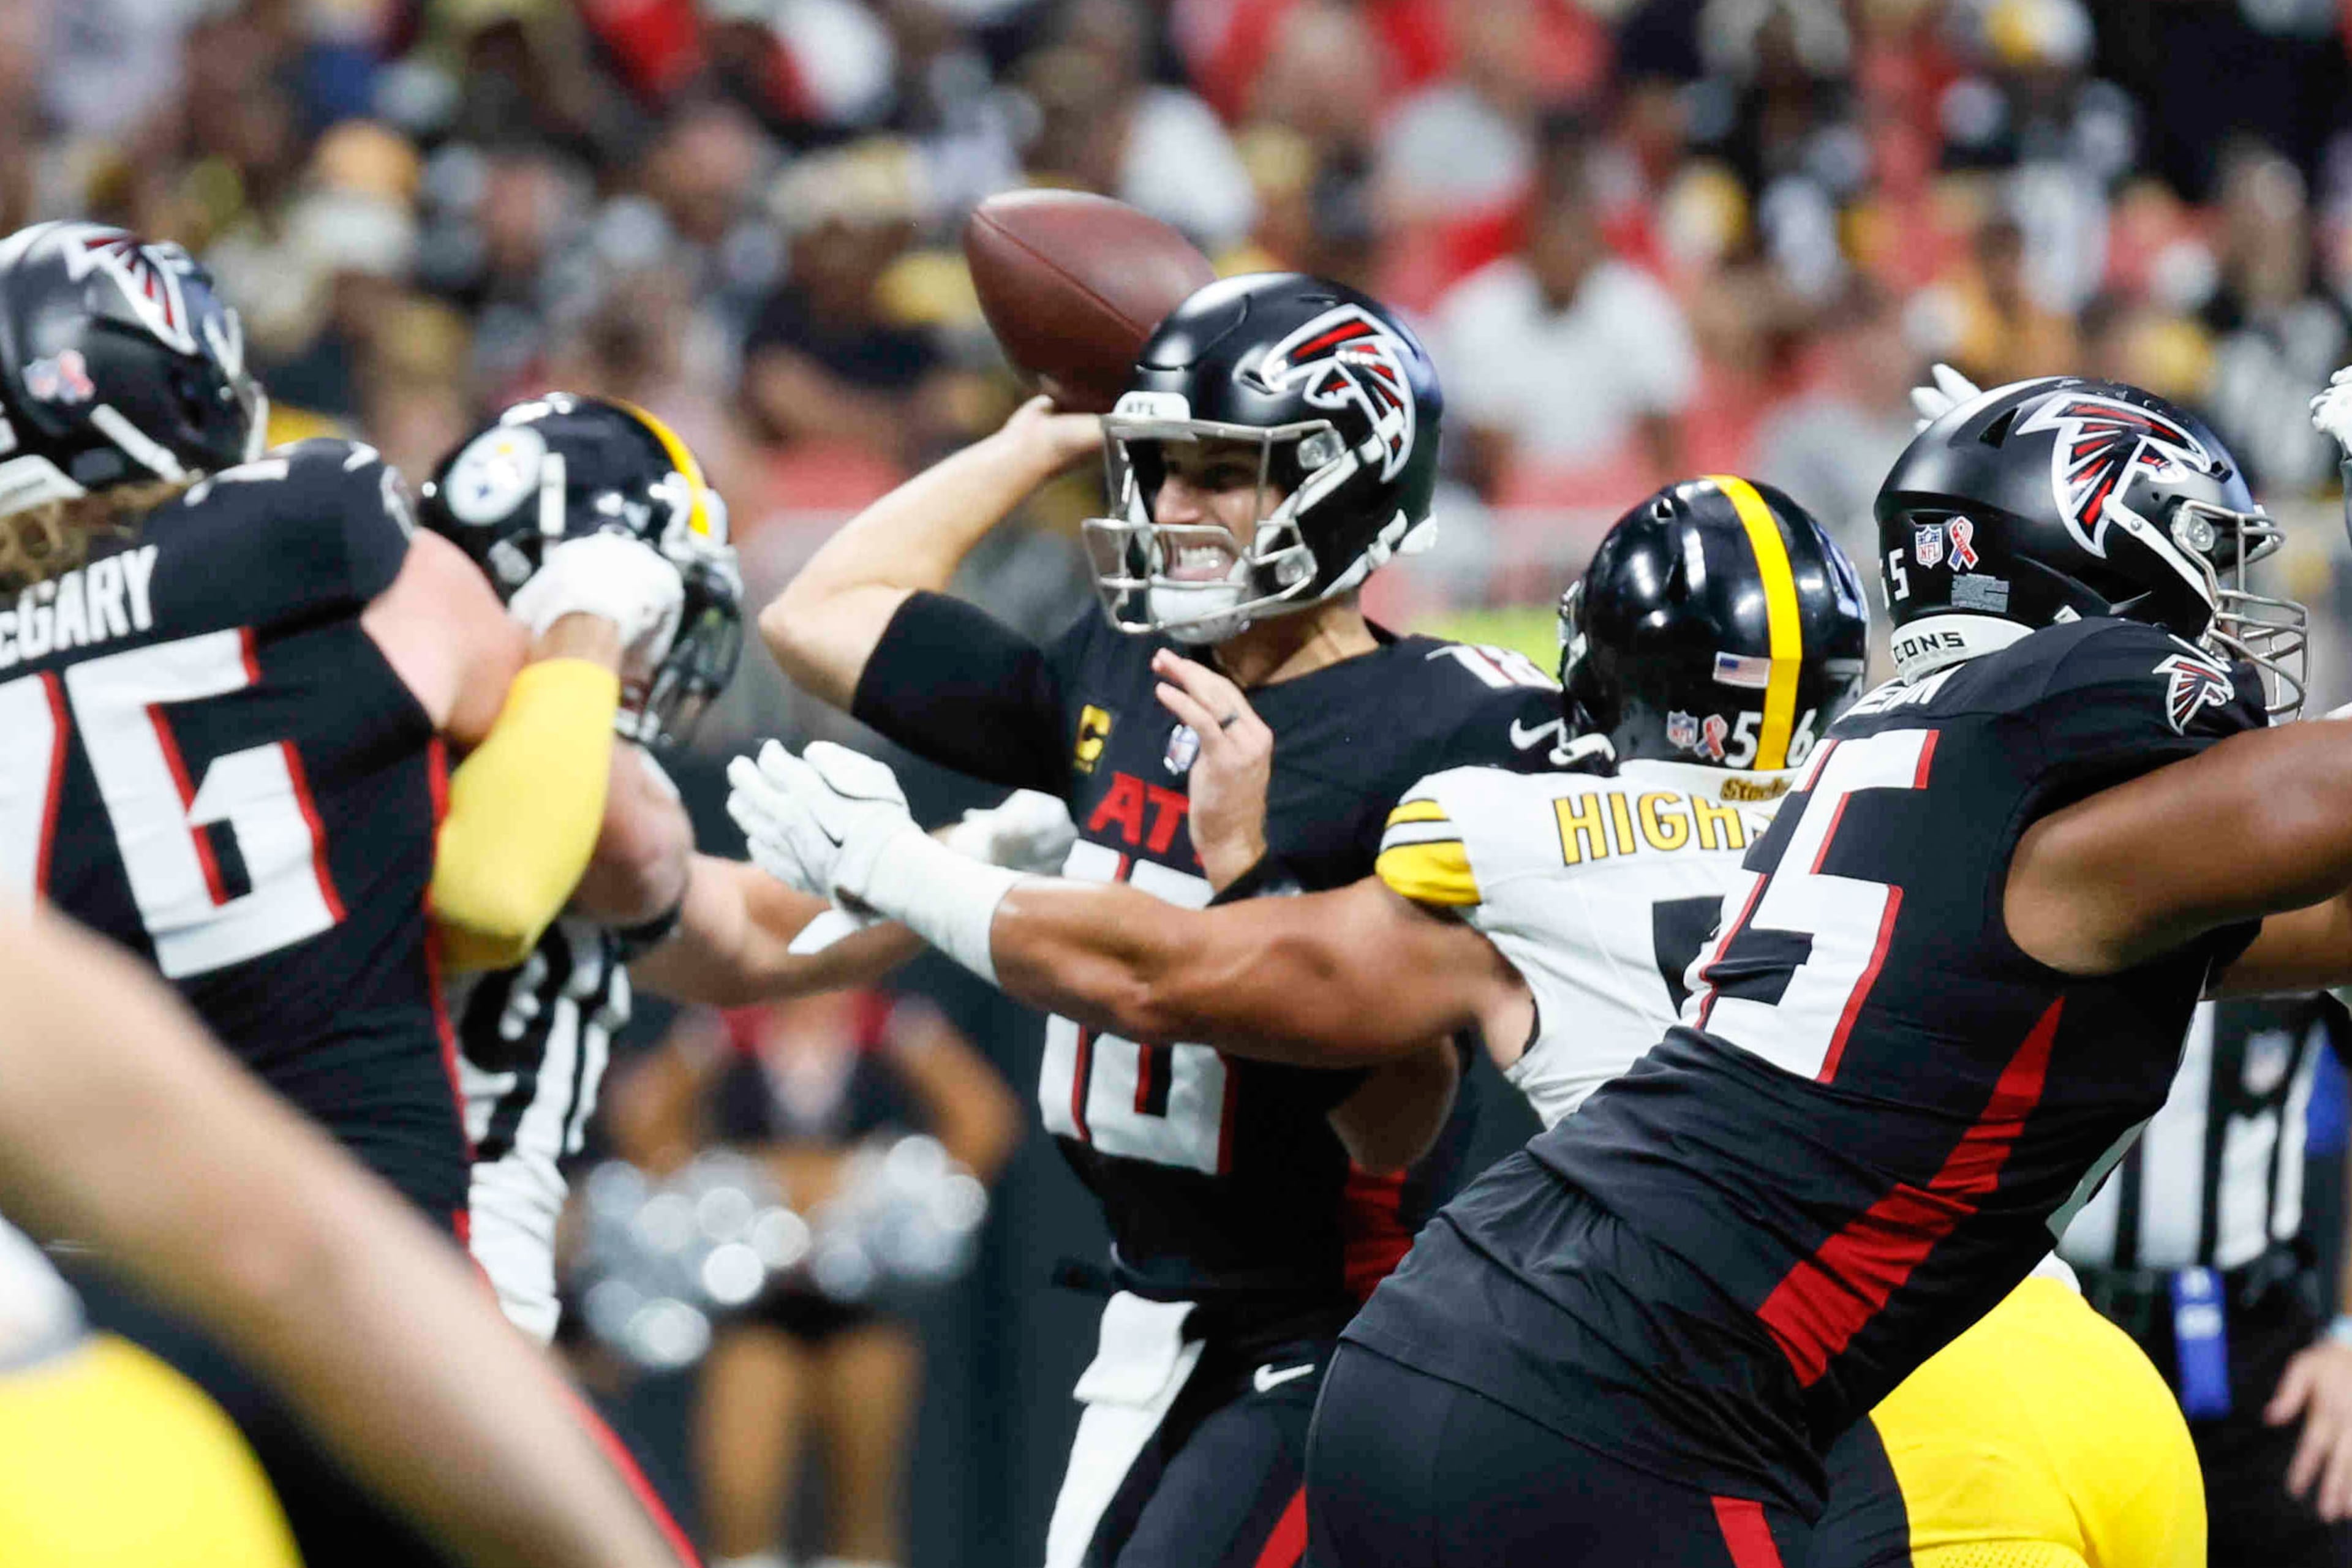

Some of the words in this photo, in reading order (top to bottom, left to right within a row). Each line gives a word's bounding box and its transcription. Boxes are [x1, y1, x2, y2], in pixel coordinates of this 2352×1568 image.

[1724, 709, 1817, 768] 56
[1088, 771, 1205, 869] AT
[1553, 791, 1776, 867] HIGH
